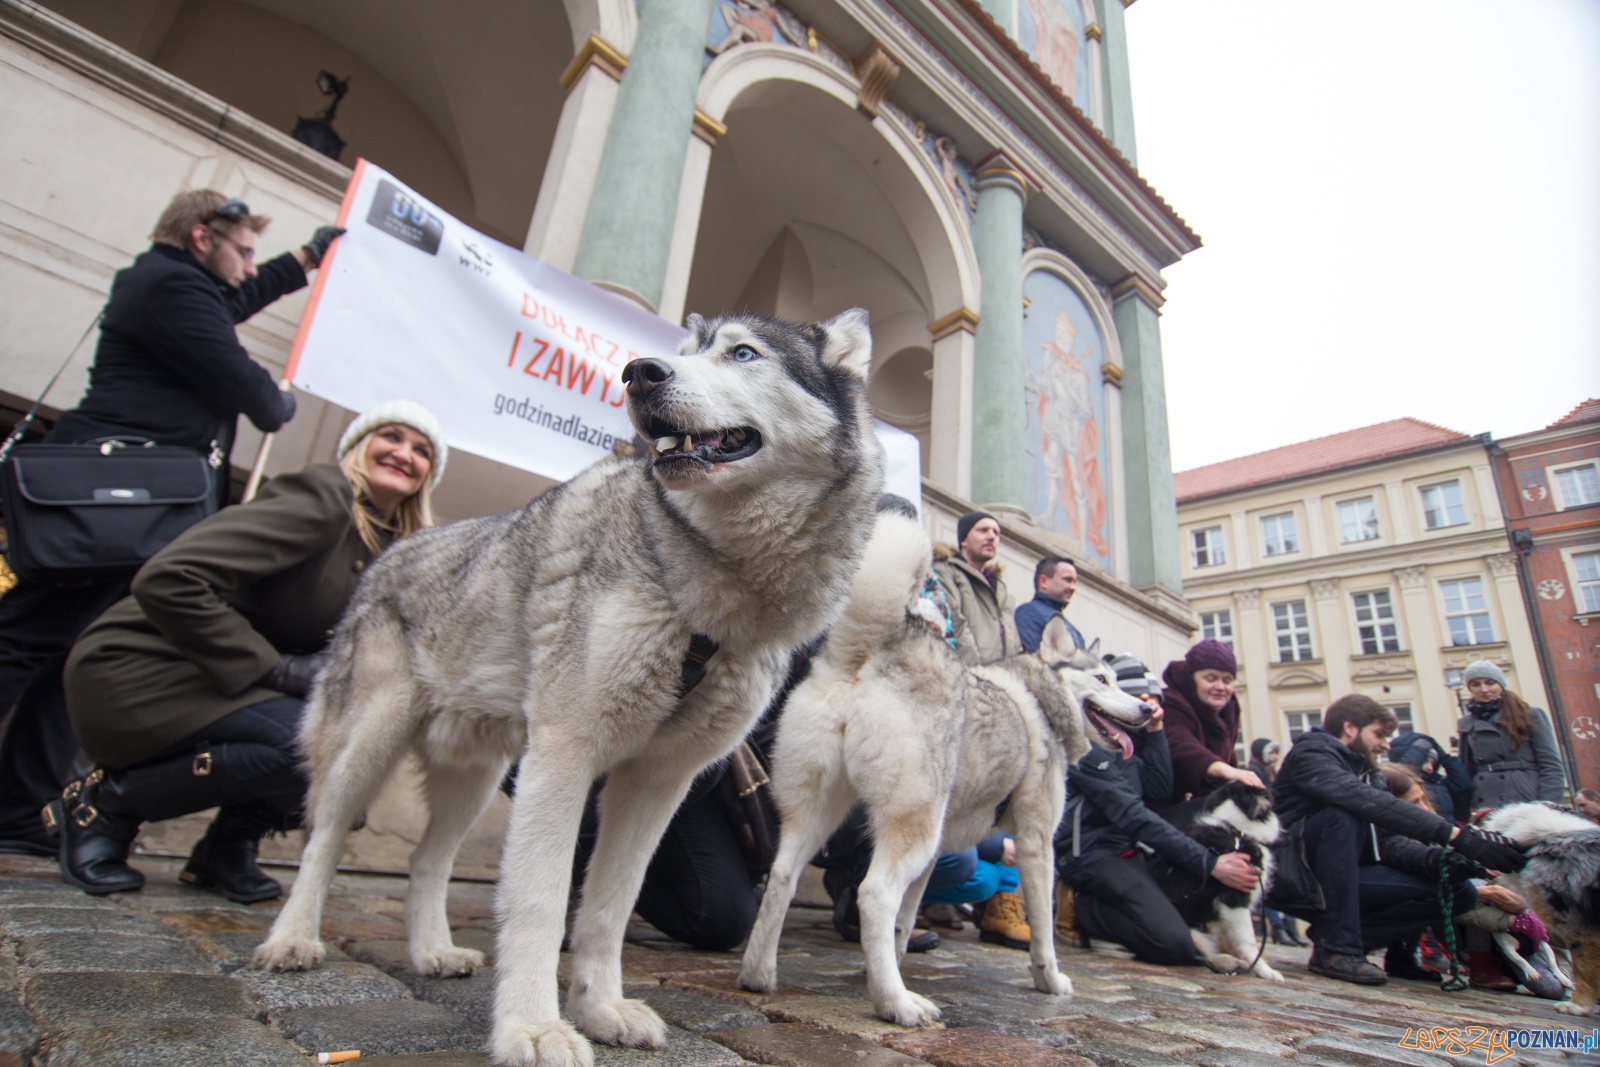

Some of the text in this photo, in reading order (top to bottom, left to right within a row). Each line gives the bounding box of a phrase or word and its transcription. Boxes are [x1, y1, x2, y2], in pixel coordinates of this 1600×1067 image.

[506, 330, 626, 408] I ZAWYJ
[493, 393, 622, 450] godzinadlazie
